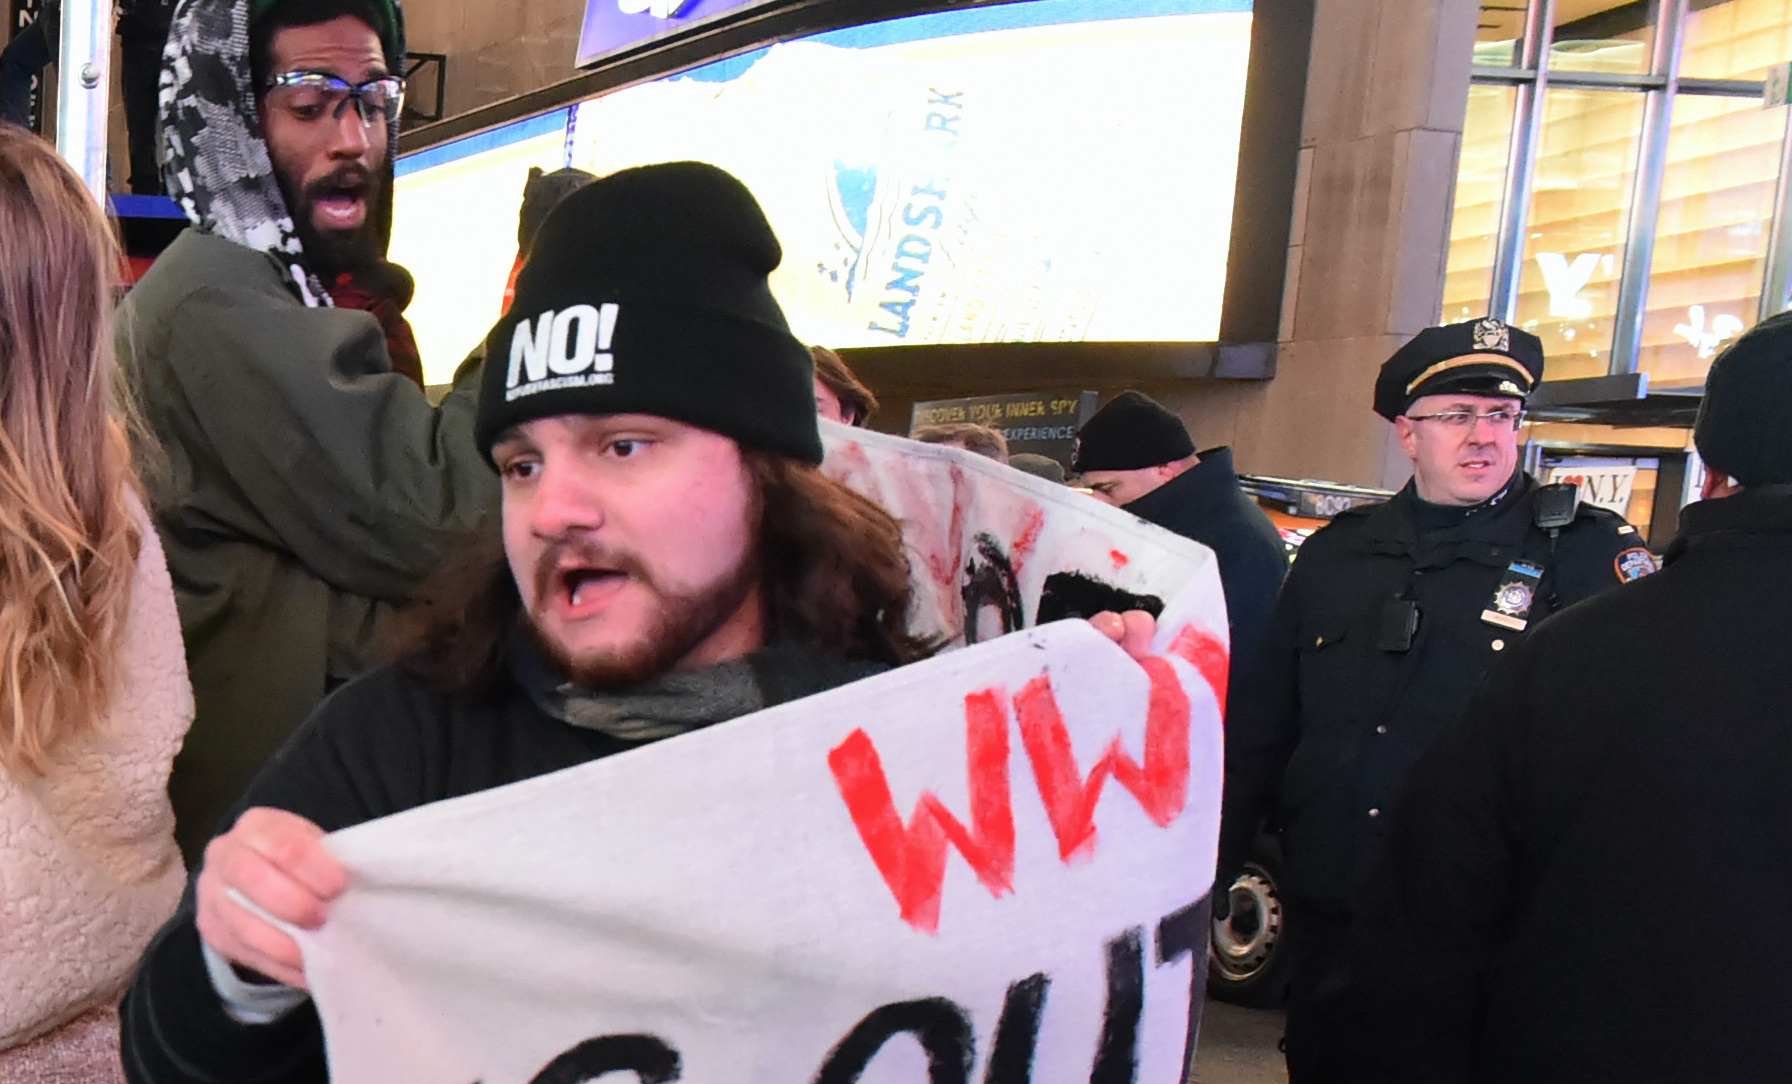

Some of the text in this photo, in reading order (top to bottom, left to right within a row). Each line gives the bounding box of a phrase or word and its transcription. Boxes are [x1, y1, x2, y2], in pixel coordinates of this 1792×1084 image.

[868, 87, 964, 338] LANDSHRK
[506, 303, 619, 388] NO!
[1050, 399, 1077, 415] SPY
[827, 623, 1229, 937] WW
